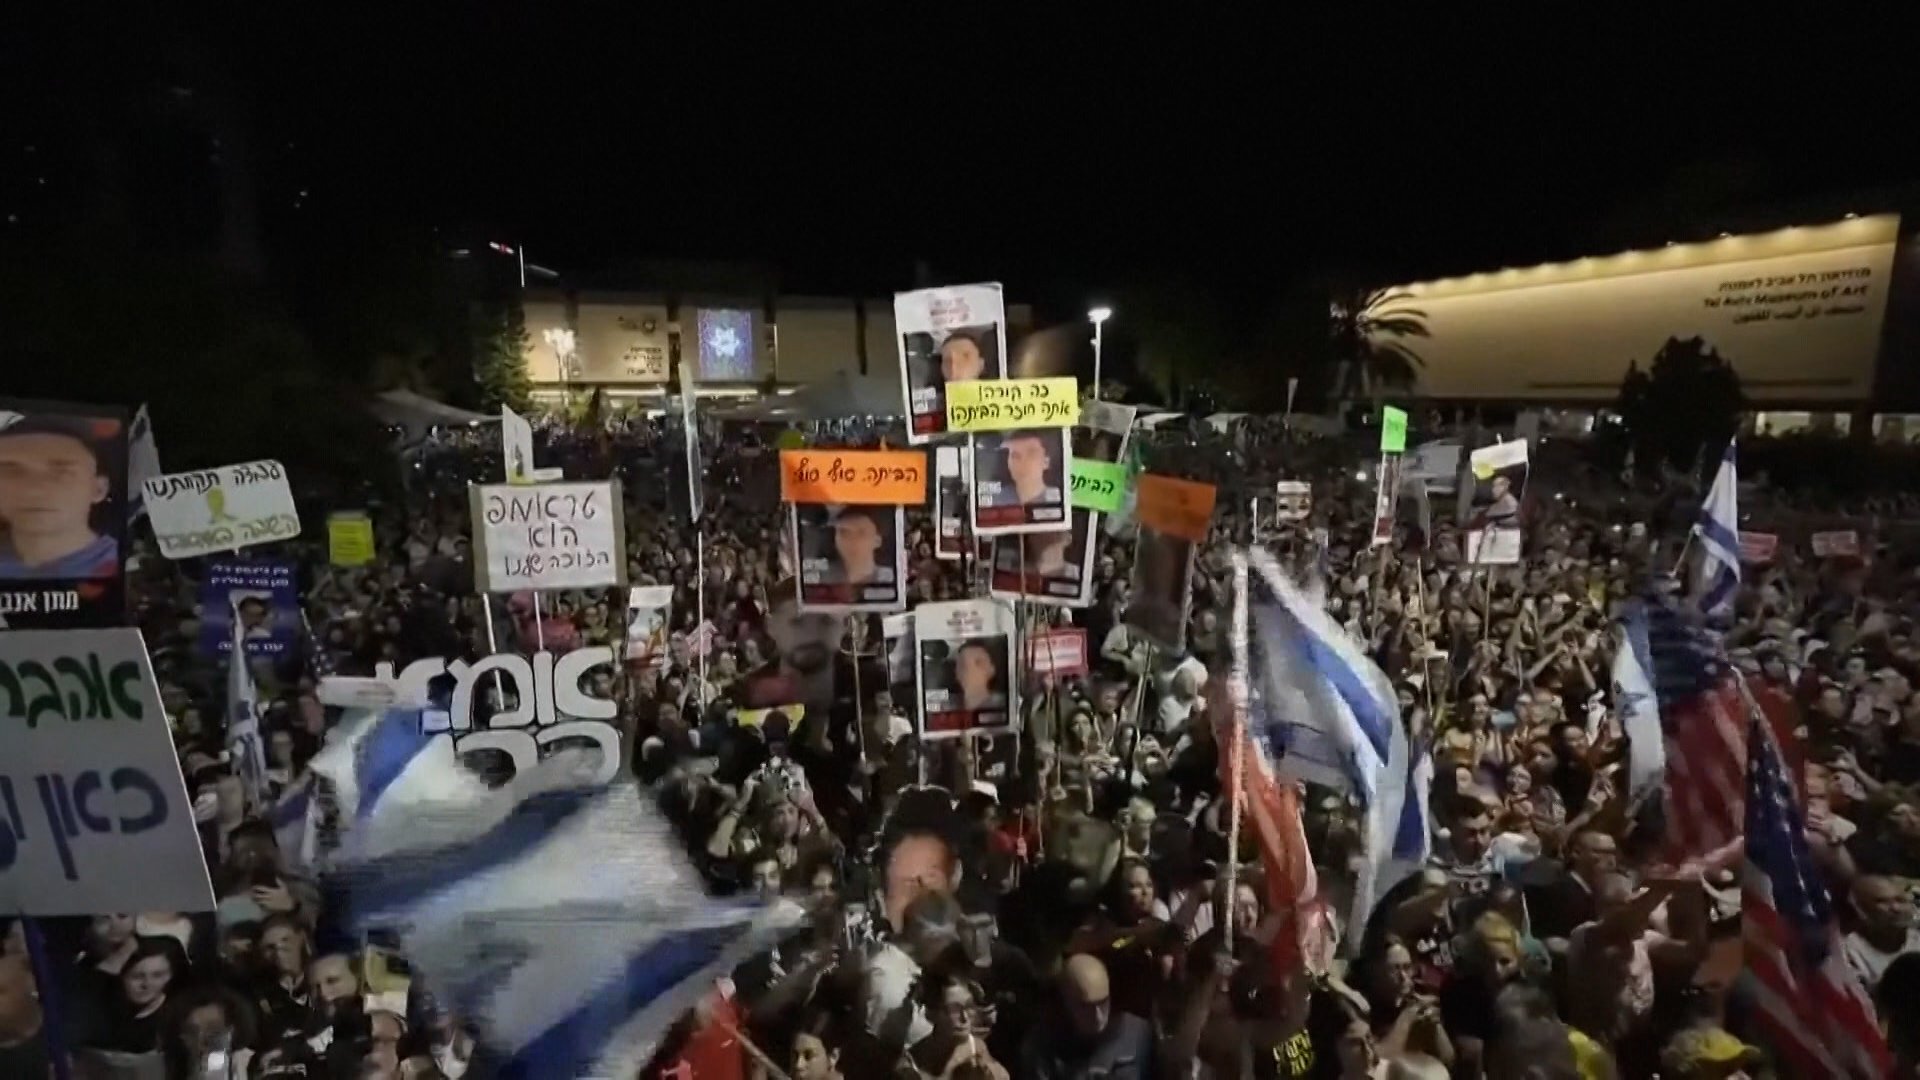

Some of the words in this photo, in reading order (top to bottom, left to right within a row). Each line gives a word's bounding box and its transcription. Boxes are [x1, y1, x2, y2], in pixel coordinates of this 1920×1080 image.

[1754, 291, 1817, 304] Museum
[1820, 287, 1838, 299] of
[1841, 285, 1868, 296] Art
[1003, 403, 1036, 420] חוזר
[1041, 401, 1071, 421] אתה
[828, 457, 856, 483] סוף
[527, 522, 579, 549] הוא
[42, 591, 79, 613] מתן
[34, 766, 169, 882] כאן
